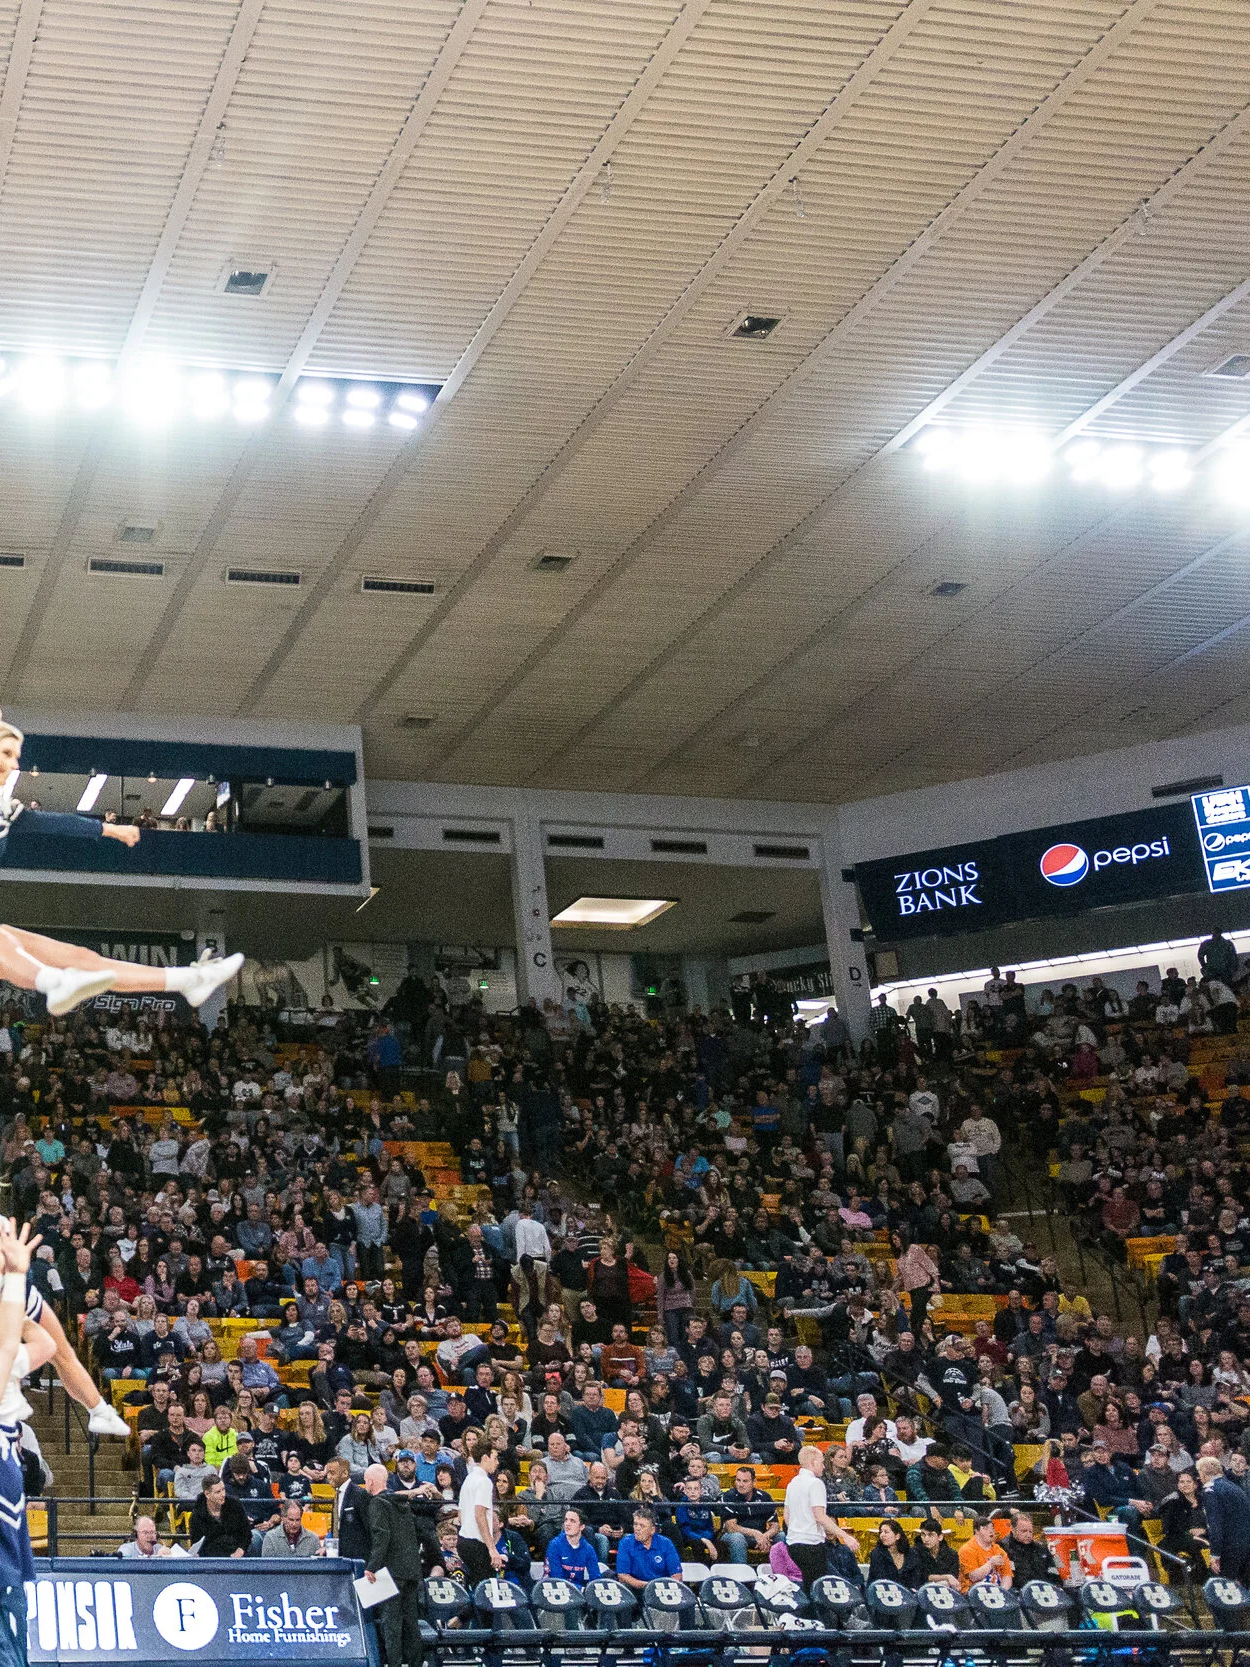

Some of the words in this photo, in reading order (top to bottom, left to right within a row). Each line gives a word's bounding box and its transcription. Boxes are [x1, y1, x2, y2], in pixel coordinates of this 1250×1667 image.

[1094, 837, 1170, 871] pepsi
[894, 862, 979, 893] ZIONS
[898, 884, 982, 915] BANK
[533, 952, 547, 968] C
[849, 967, 862, 980] D
[23, 1580, 138, 1651] PONSOR
[175, 1598, 196, 1632] F
[229, 1591, 340, 1630] Fisher
[229, 1627, 271, 1644] Home
[275, 1627, 352, 1648] Furnishings
